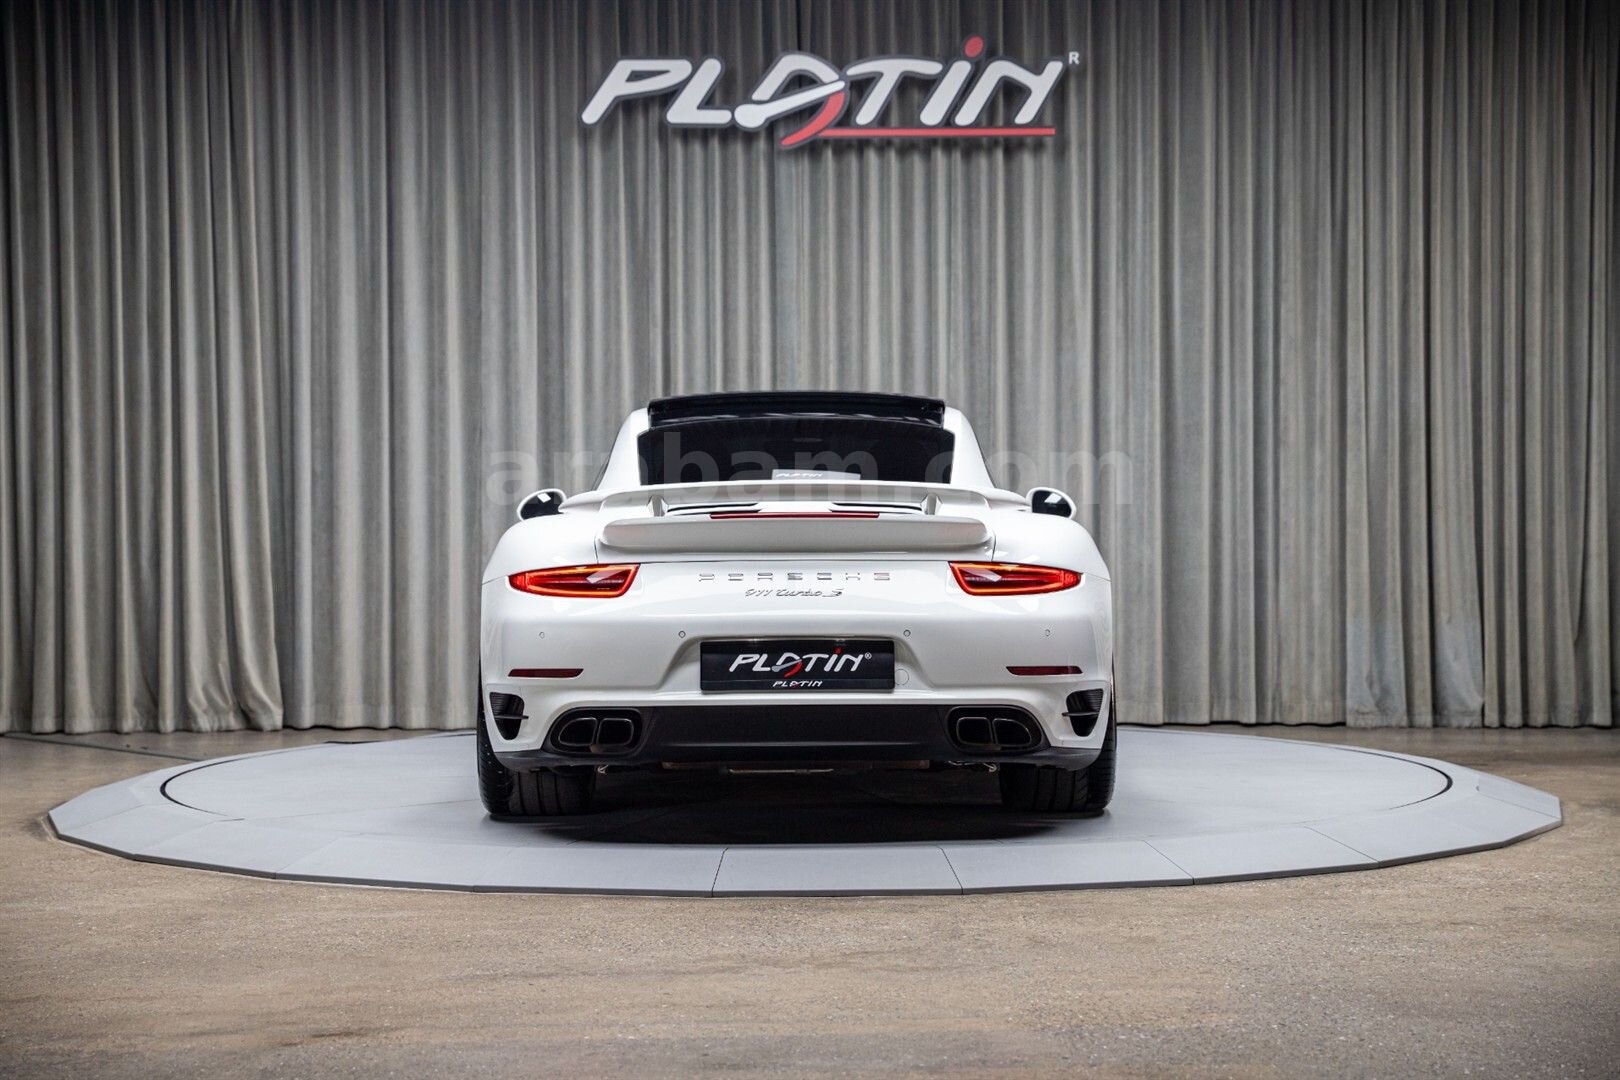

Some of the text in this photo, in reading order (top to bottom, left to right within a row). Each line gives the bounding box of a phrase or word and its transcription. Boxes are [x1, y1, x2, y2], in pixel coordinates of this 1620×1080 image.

[698, 572, 891, 582] PORSCHE
[745, 588, 773, 597] 911
[821, 587, 845, 598] S
